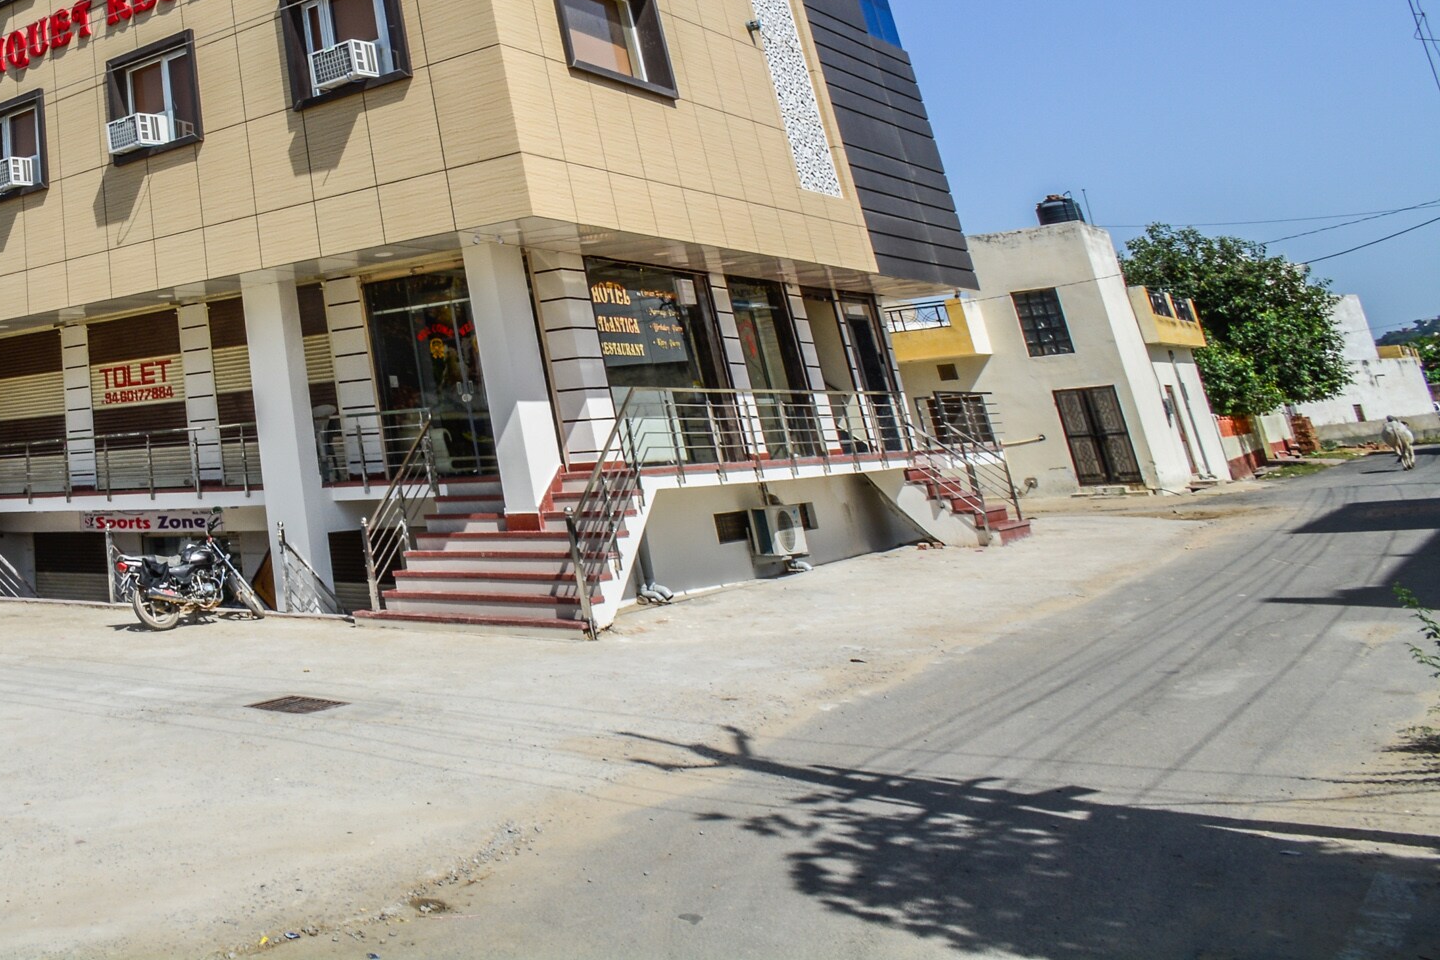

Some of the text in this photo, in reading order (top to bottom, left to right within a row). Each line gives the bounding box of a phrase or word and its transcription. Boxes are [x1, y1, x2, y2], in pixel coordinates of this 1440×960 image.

[591, 282, 631, 306] HOTEL
[601, 342, 645, 356] ESTAURANT
[95, 516, 151, 530] Sports
[157, 515, 206, 530] Zone
